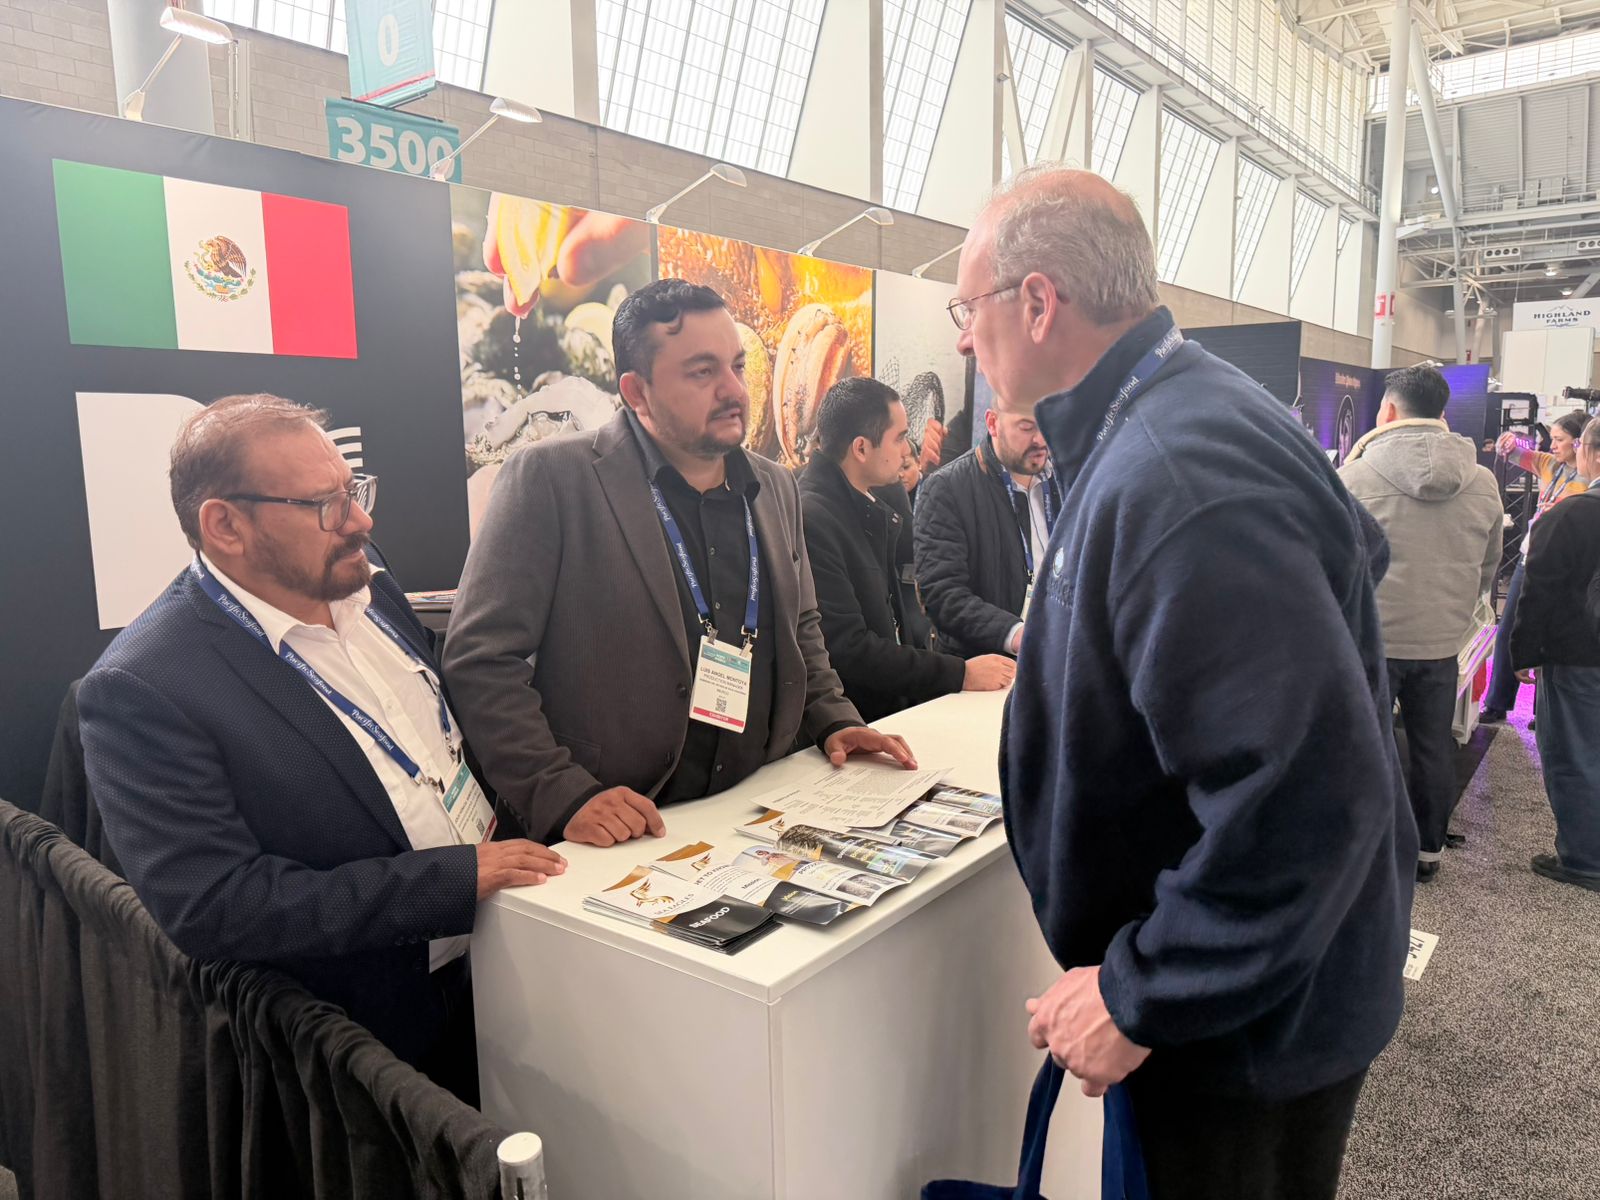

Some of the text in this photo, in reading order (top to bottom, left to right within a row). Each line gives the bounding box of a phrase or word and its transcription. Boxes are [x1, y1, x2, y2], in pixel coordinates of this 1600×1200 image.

[335, 116, 456, 181] 3500
[1533, 310, 1591, 319] HIGHLAND
[688, 906, 731, 929] SEAFOOD
